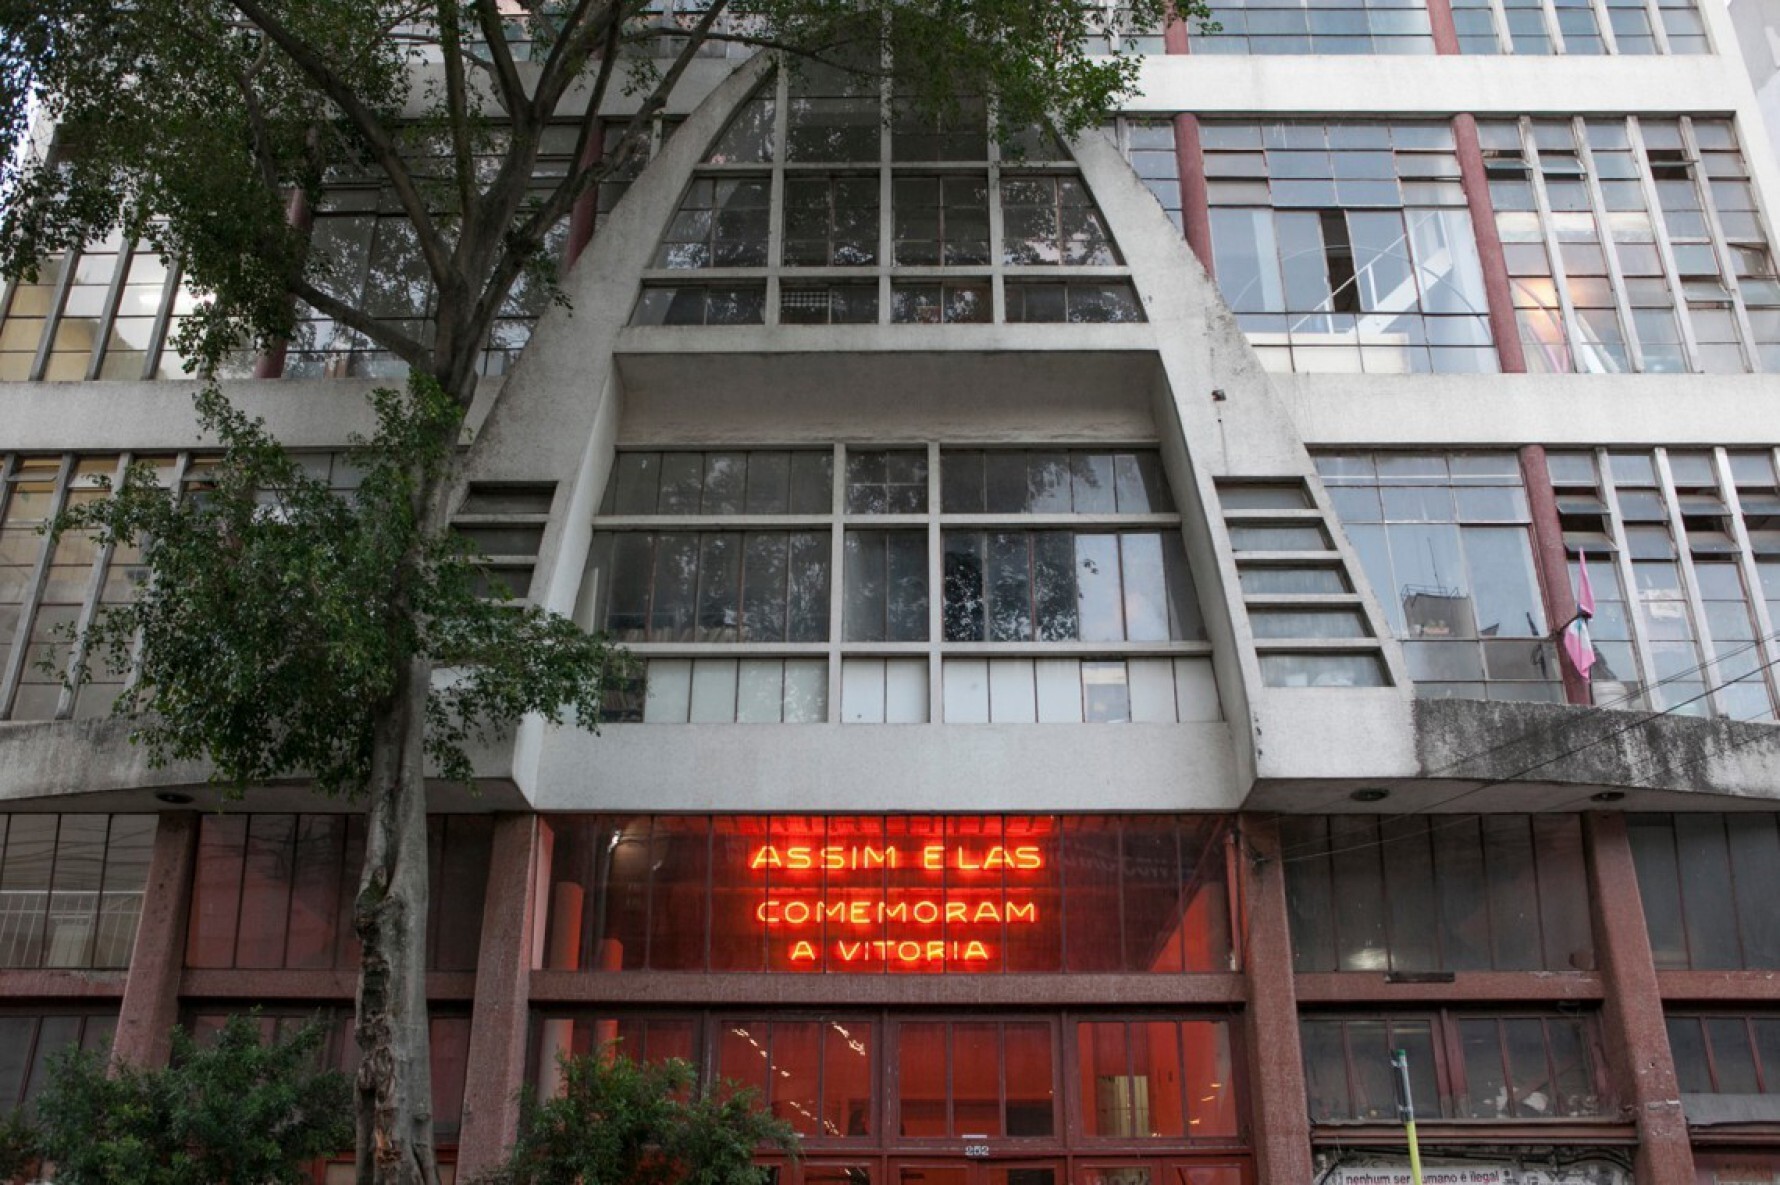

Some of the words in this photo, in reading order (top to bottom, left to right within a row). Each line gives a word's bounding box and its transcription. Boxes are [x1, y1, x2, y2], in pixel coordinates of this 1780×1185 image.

[751, 845, 896, 870] ASSIM
[924, 845, 1041, 870] ELAS
[757, 901, 1036, 924] COMEMORAM
[790, 940, 816, 961] A
[838, 940, 989, 962] VITORIA
[1346, 1173, 1390, 1184] nenhum
[1394, 1174, 1410, 1184] ser
[1414, 1173, 1457, 1184] umano
